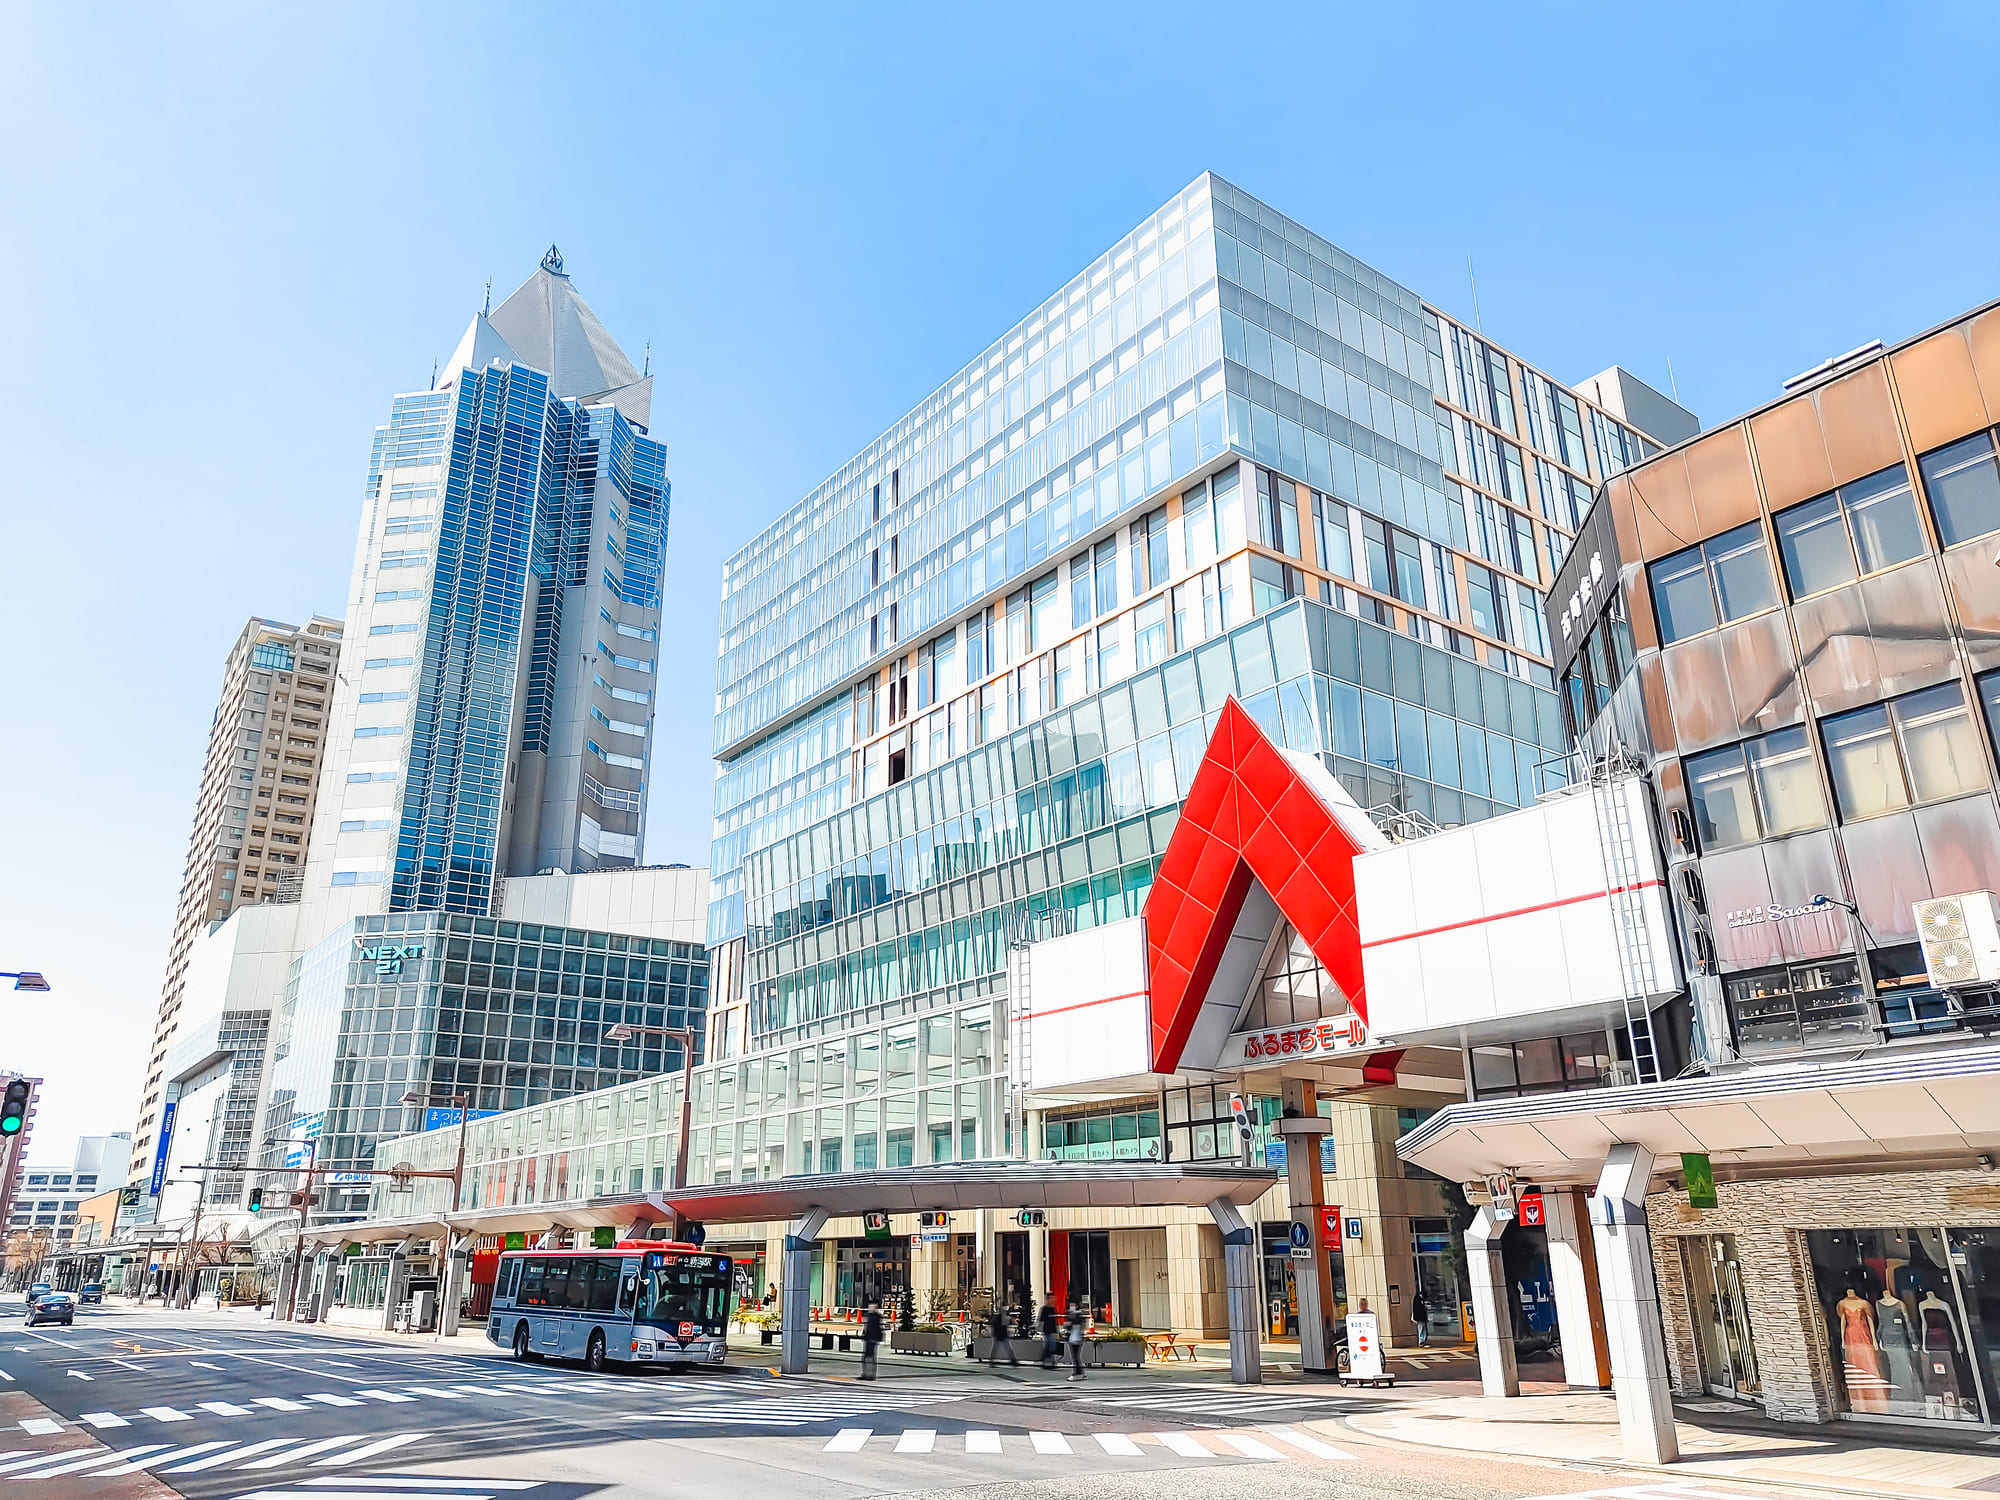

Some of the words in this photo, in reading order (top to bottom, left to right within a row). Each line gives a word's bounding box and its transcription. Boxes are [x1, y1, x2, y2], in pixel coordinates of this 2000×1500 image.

[359, 944, 424, 960] NEXT
[375, 959, 401, 974] 21
[1243, 1019, 1364, 1059] ふるまちモール
